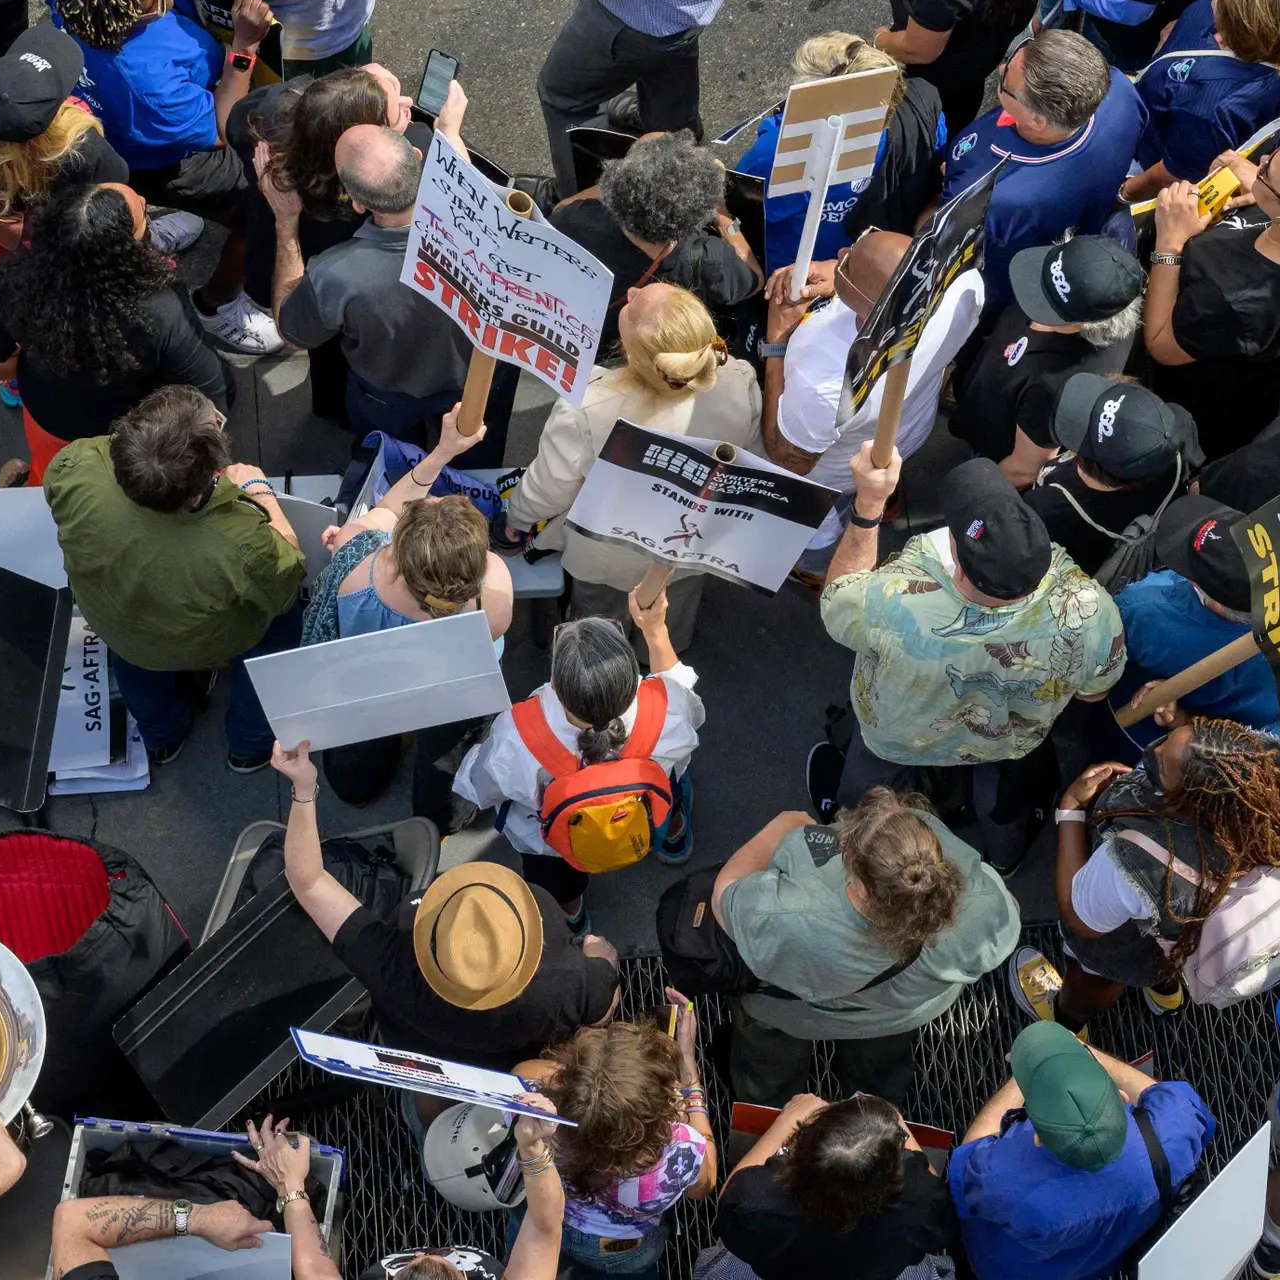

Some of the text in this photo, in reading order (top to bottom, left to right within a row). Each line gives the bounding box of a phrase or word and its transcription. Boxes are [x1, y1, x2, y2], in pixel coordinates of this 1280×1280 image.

[434, 138, 489, 212] WHEN
[449, 204, 542, 284] YOU GET
[493, 204, 599, 280] WRITERS
[421, 204, 600, 339] THE APPRENTICE
[416, 239, 581, 359] WRITERS GUILD
[478, 309, 499, 326] ON
[485, 285, 512, 307] what
[515, 302, 550, 324] came
[412, 260, 579, 393] STRIKE!
[708, 485, 744, 497] EAST
[712, 475, 754, 491] GUILD
[714, 469, 776, 488] WRITERS
[725, 483, 789, 504] AMERICA
[651, 481, 754, 521] STANDS WITH
